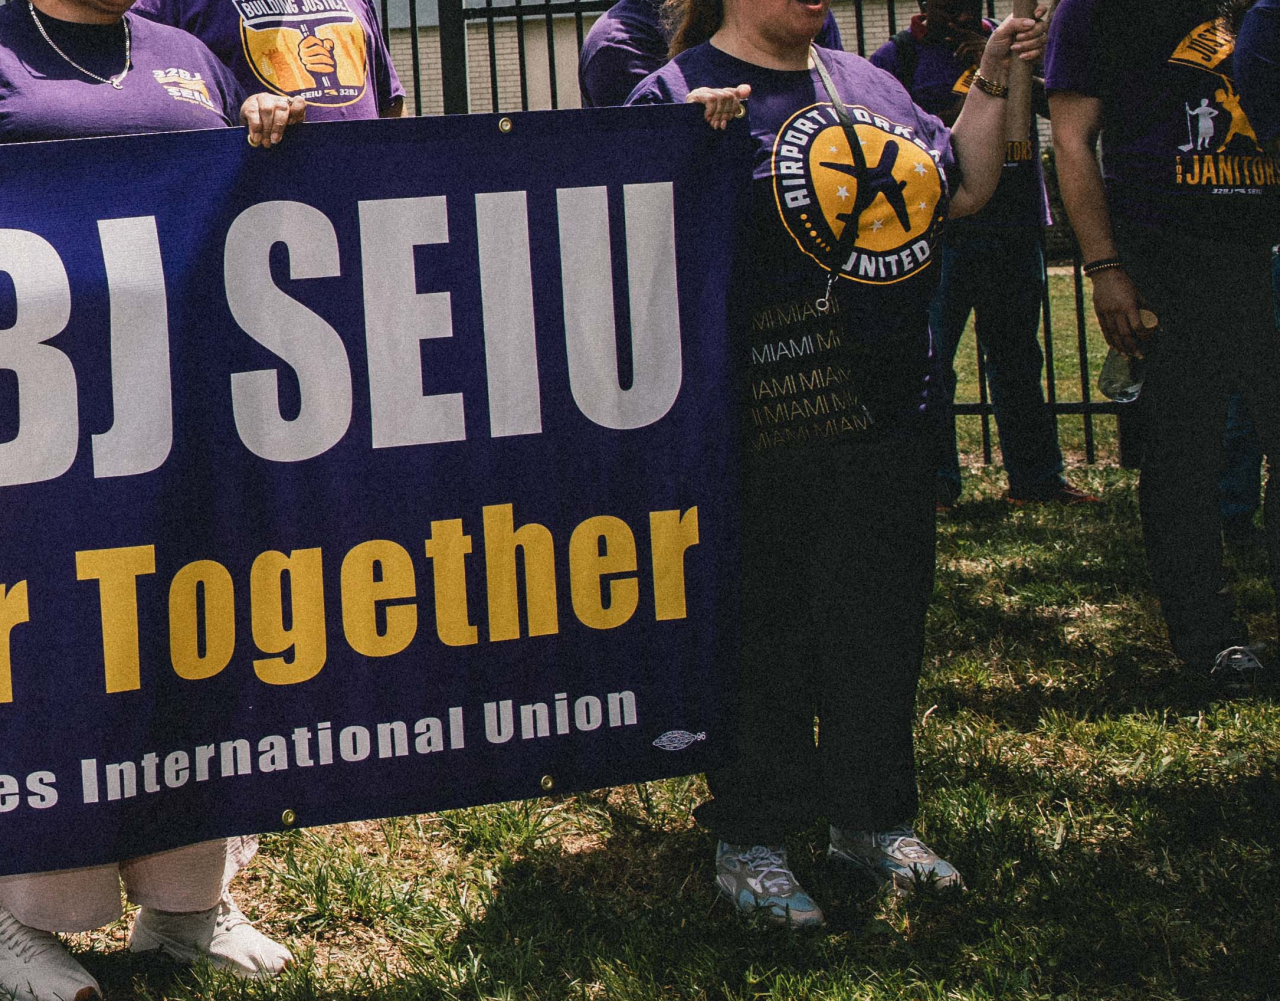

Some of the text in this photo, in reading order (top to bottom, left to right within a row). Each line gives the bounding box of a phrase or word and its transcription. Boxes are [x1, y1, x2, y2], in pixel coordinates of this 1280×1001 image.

[780, 106, 827, 210] AIRPORT
[223, 181, 683, 462] SEIU
[751, 334, 815, 365] MIAMI
[75, 502, 699, 694] Together
[80, 707, 466, 804] International
[483, 689, 638, 744] Union
